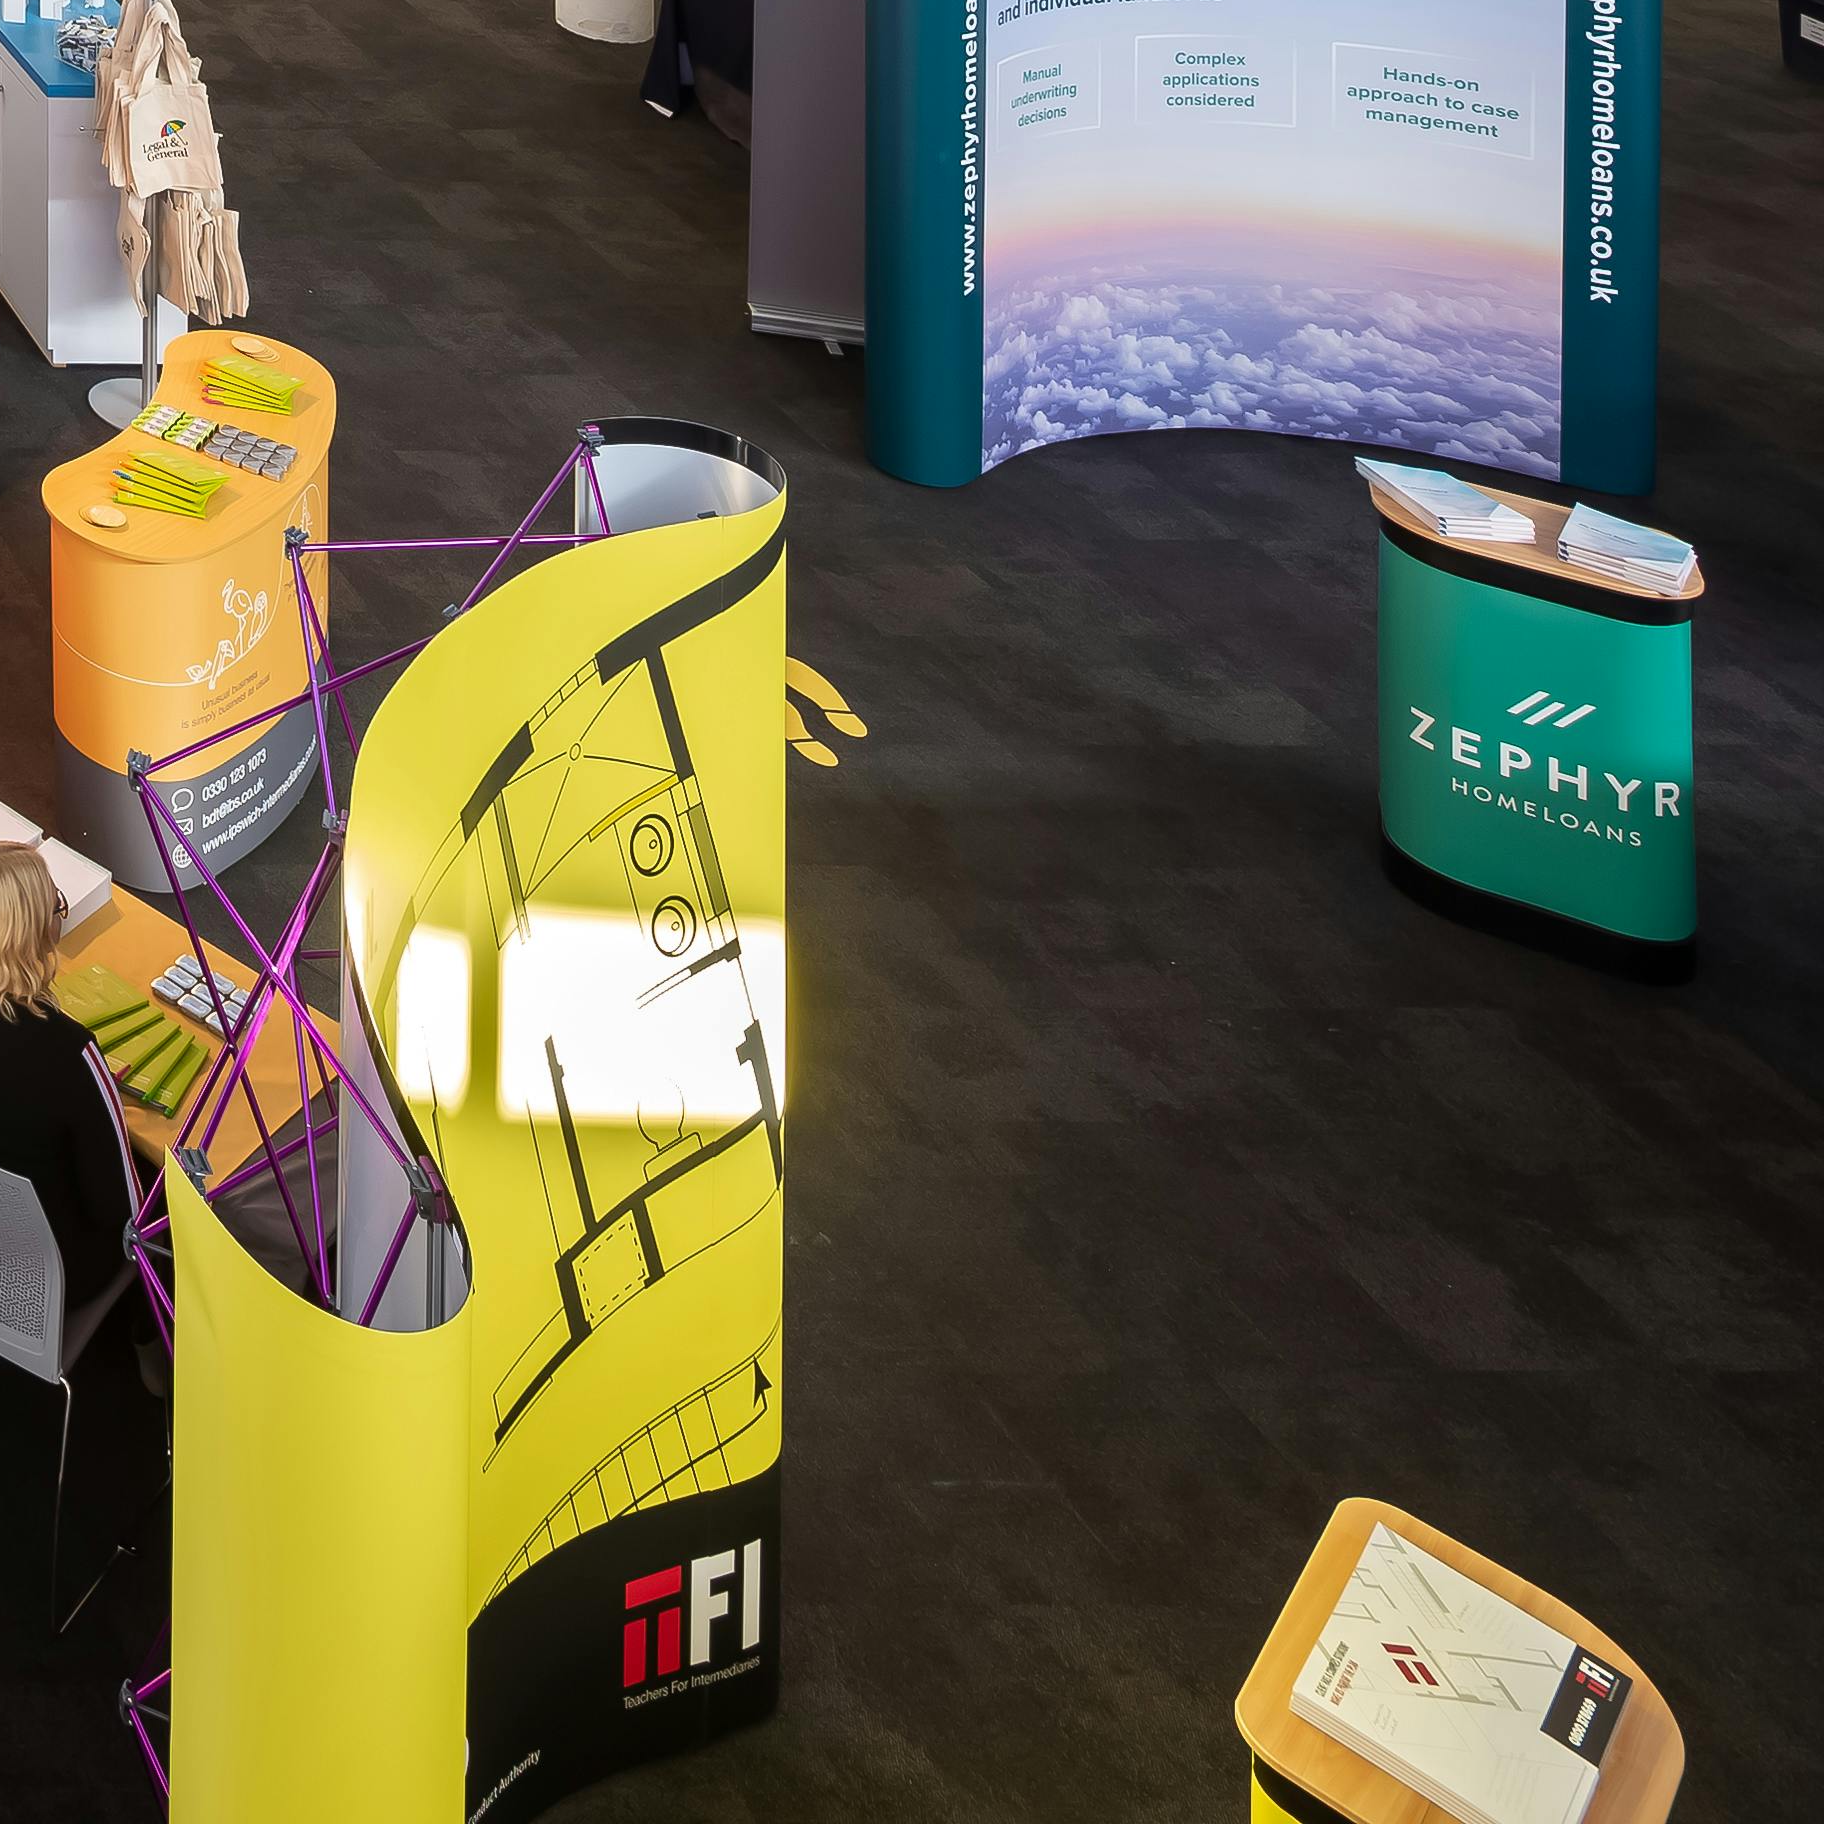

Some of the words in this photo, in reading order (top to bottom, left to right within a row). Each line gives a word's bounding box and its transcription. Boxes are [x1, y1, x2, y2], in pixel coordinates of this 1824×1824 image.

[997, 0, 1020, 26] and
[1174, 51, 1246, 68] Complex
[1023, 63, 1062, 84] Manual
[1162, 72, 1260, 90] applications
[1383, 66, 1480, 95] Hands-on
[1011, 82, 1077, 111] underwriting
[1166, 92, 1255, 109] considered
[1347, 84, 1438, 112] approach
[1443, 96, 1466, 111] to
[1470, 104, 1519, 120] case
[1017, 105, 1067, 127] decisions
[1365, 106, 1499, 138] management
[143, 141, 169, 154] Legal
[170, 138, 180, 148] &
[147, 148, 189, 163] General
[202, 777, 227, 802] 0330
[229, 764, 246, 785] 123
[247, 748, 267, 772] 1073
[1408, 705, 1681, 818] ZEPHYR
[1451, 777, 1642, 848] HOMELOANS
[623, 1685, 669, 1710] Teachers
[671, 1677, 688, 1694] For
[691, 1655, 760, 1687] Intermediaries
